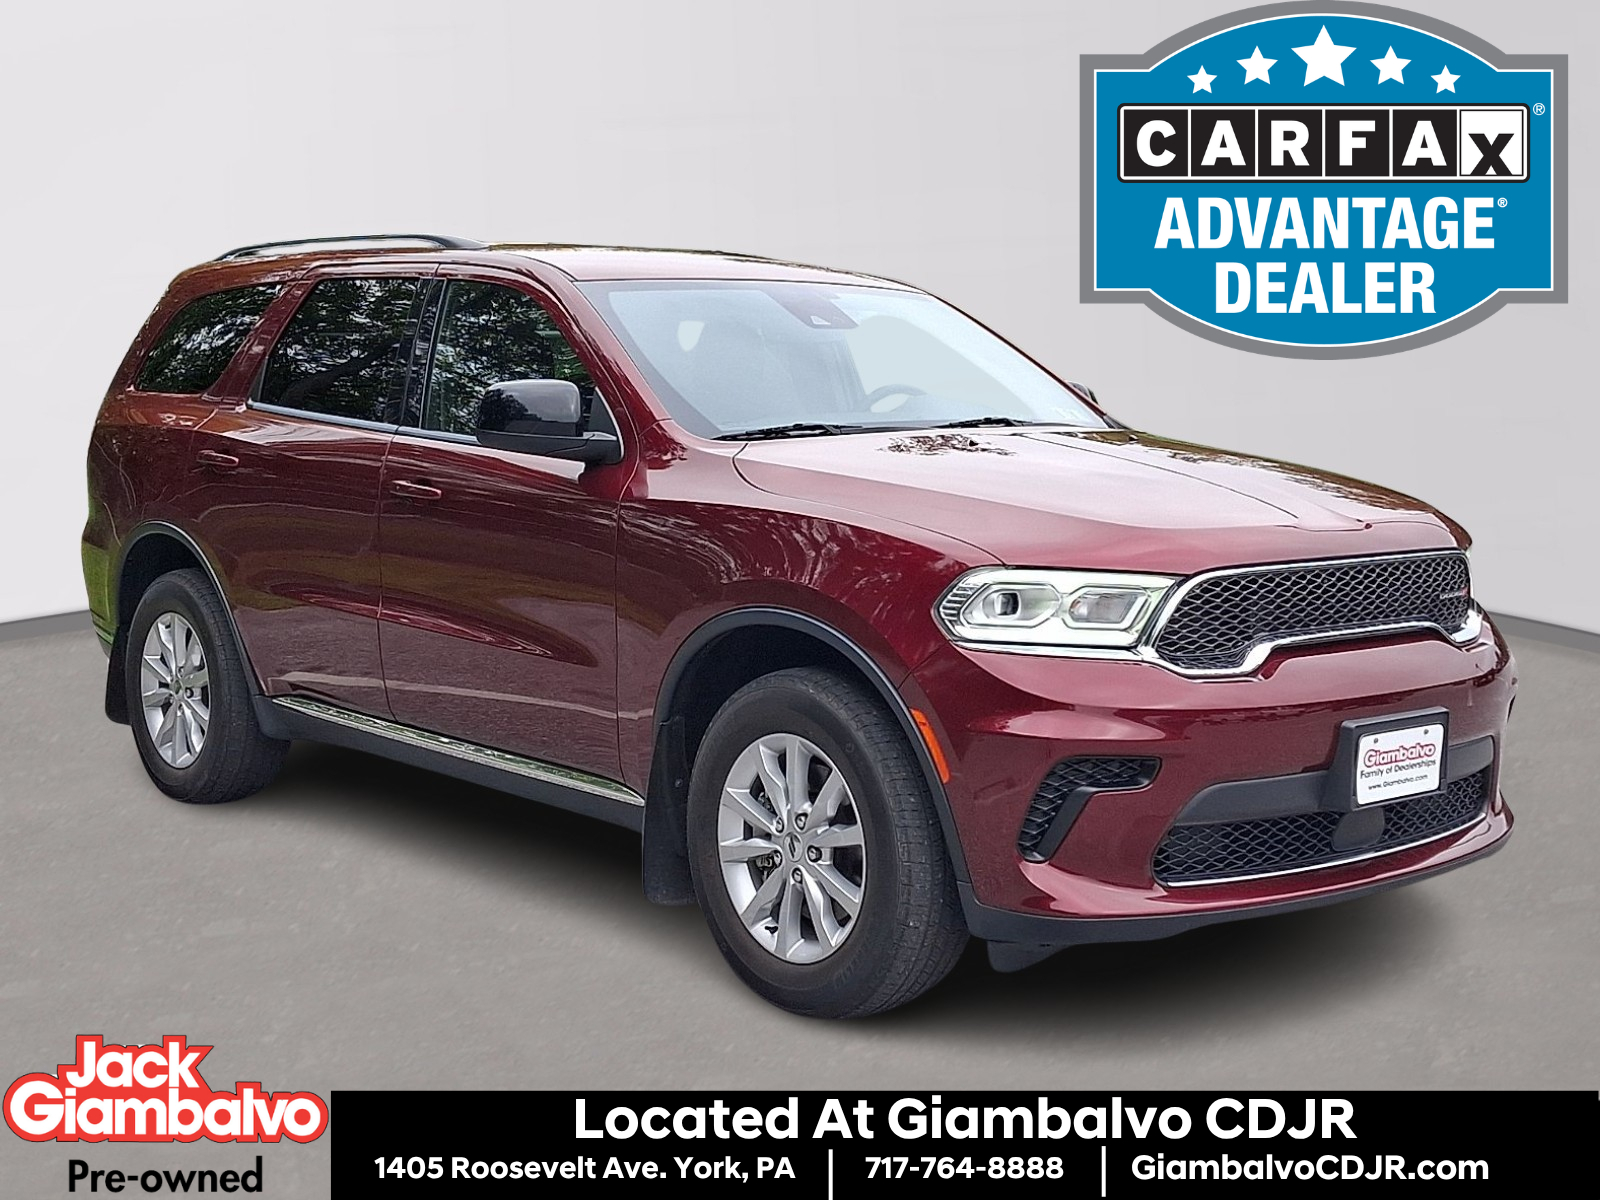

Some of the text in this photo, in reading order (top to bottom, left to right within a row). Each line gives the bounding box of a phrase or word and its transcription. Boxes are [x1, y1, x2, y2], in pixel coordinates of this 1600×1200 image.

[1365, 744, 1435, 767] Giambalvo
[1360, 768, 1384, 779] Family
[1394, 759, 1436, 772] Dealerships
